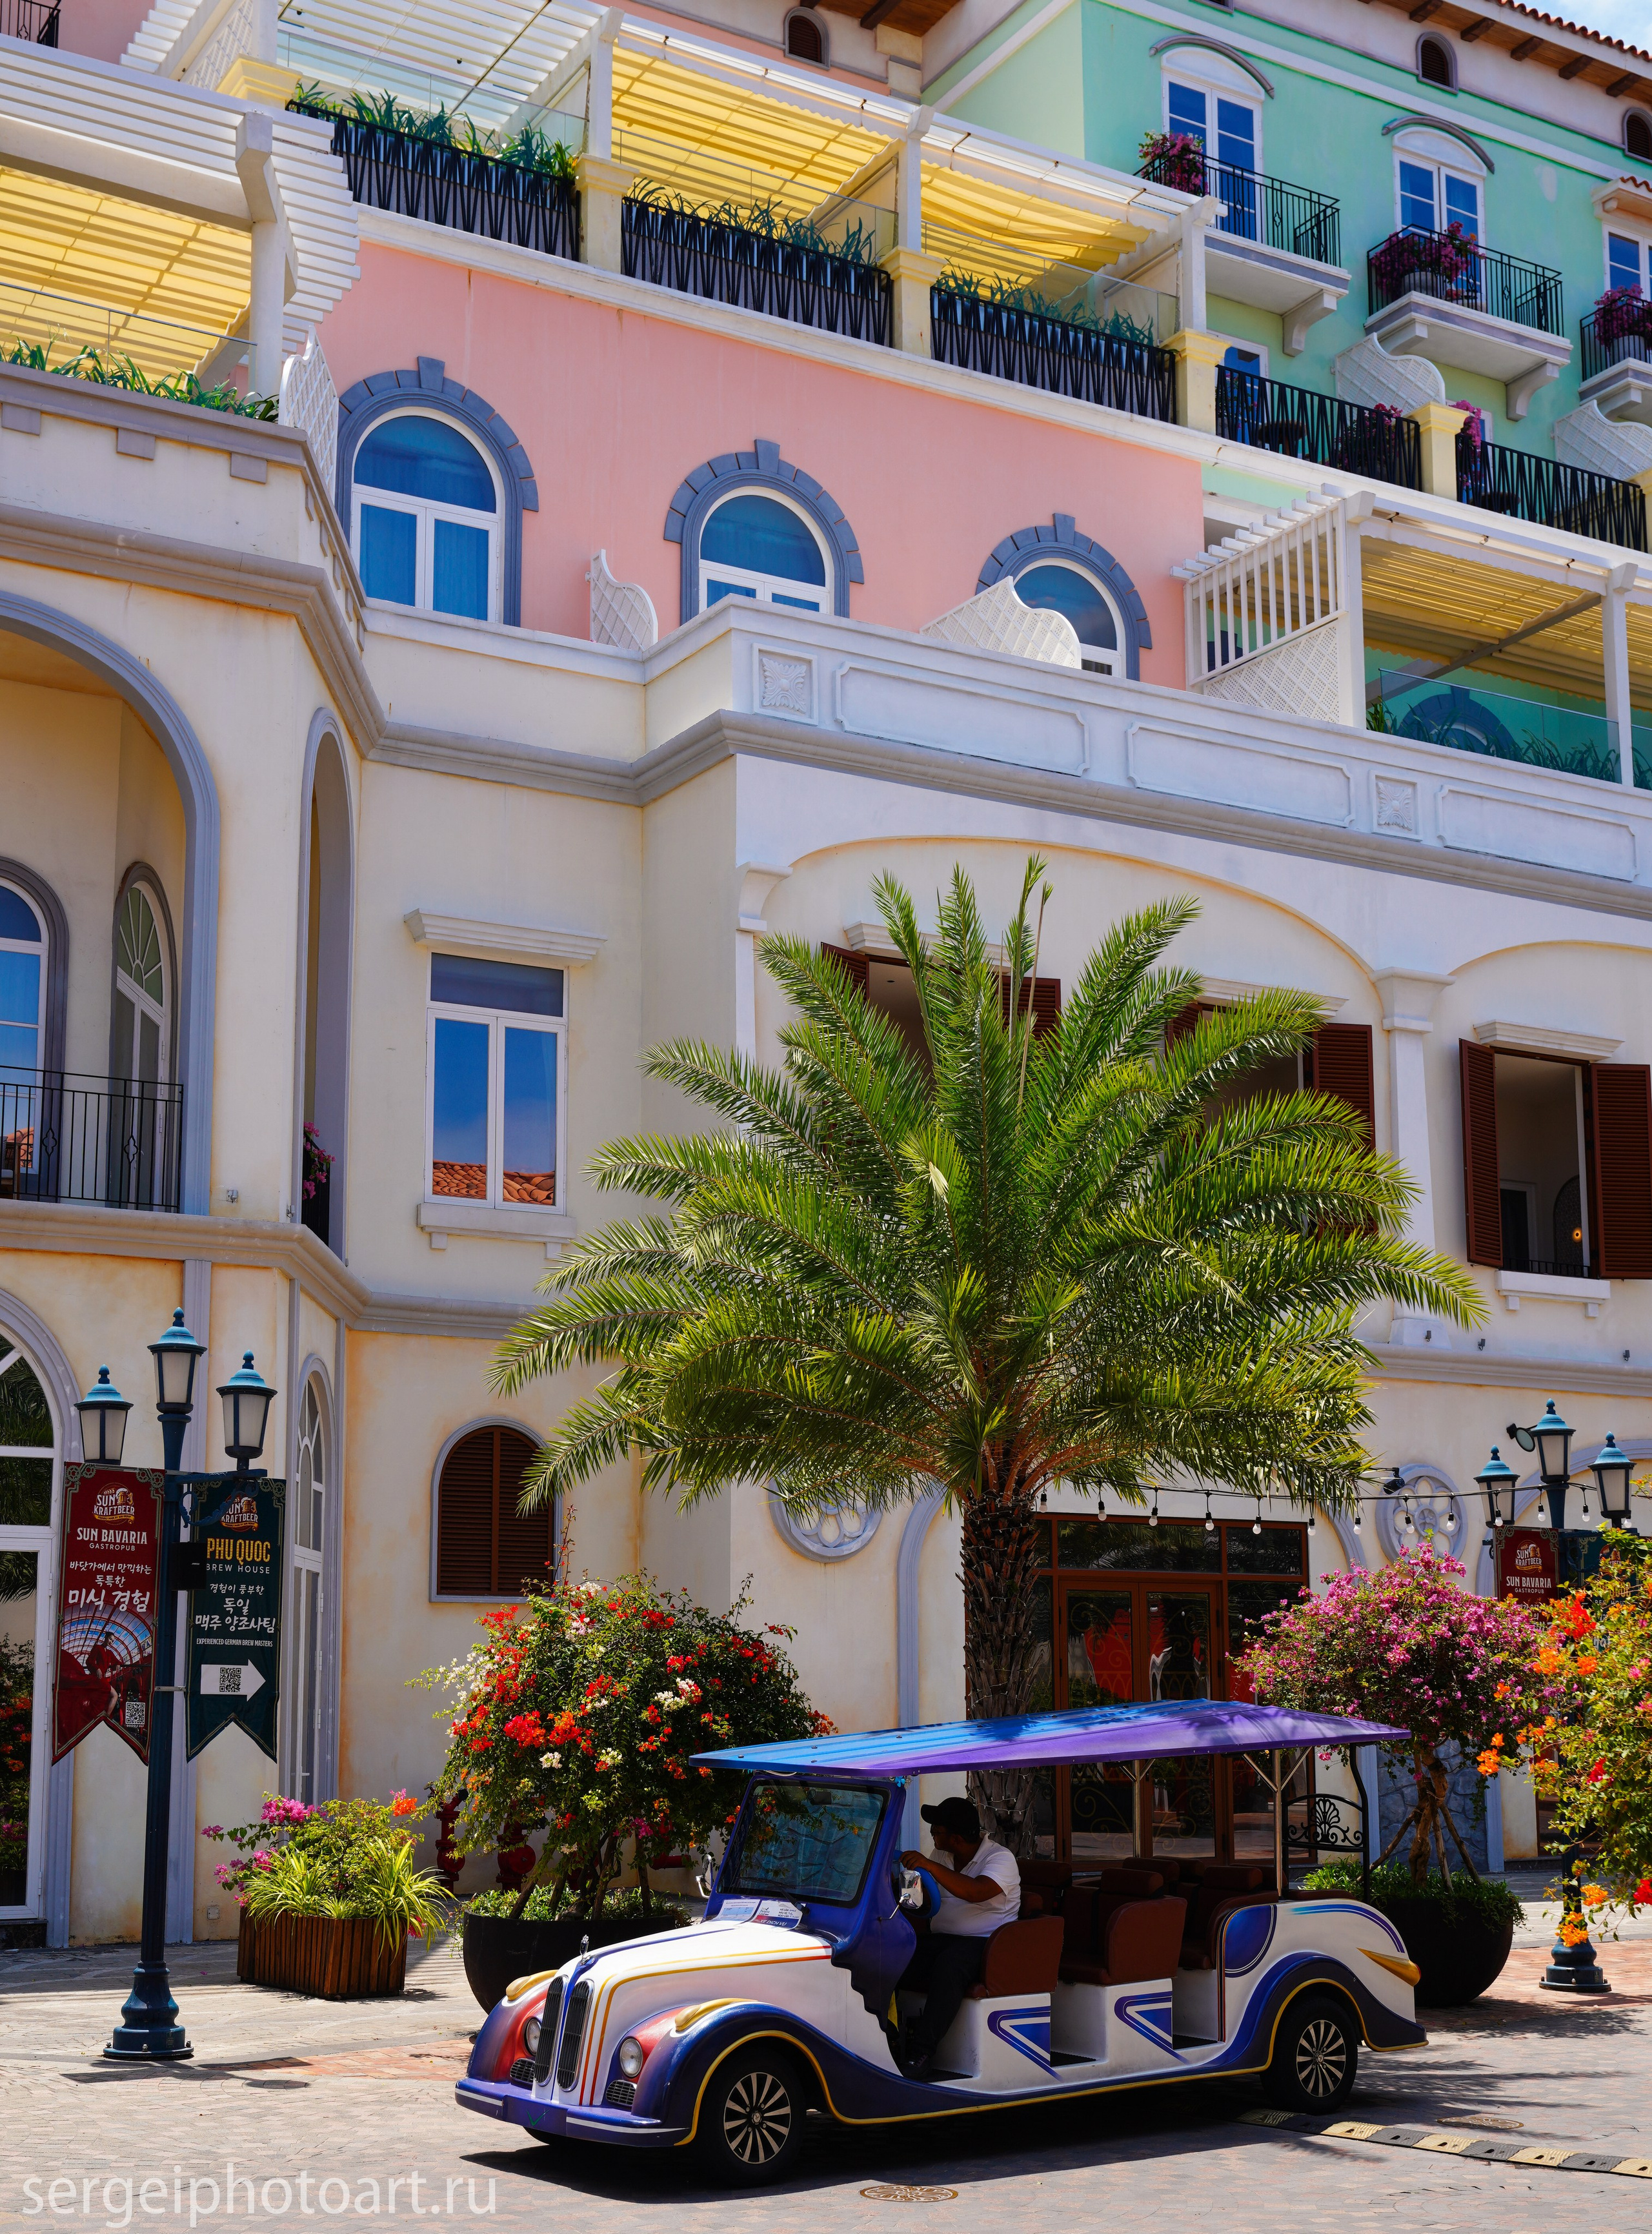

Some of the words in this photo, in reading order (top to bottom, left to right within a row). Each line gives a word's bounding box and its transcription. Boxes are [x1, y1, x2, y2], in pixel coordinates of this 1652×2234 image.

[97, 1494, 116, 1506] SUN
[94, 1505, 135, 1516] KRAFTBEER
[226, 1503, 241, 1514] UN
[221, 1513, 258, 1523] KRAFTBEER
[77, 1527, 98, 1541] SUN
[101, 1529, 148, 1545] BAVARIA
[89, 1543, 136, 1551] GASTROPUB
[206, 1538, 234, 1560] PHU
[236, 1539, 271, 1565] QUOC
[1516, 1549, 1529, 1559] SUN
[70, 1561, 116, 1572] 바닷가에서
[117, 1563, 152, 1574] 만끽하는
[1515, 1557, 1542, 1566] KRAFTBEER
[206, 1563, 232, 1572] BREW
[237, 1565, 270, 1574] HOUSE
[95, 1575, 126, 1588] 독특한
[1506, 1576, 1520, 1587] SUN
[1522, 1577, 1552, 1588] BAVARIA
[210, 1583, 236, 1594] 경험이
[239, 1585, 265, 1595] 풍부한
[68, 1588, 106, 1610] 미식
[112, 1589, 150, 1612] 경험
[223, 1598, 250, 1615] 독일
[195, 1614, 222, 1630] 맥주
[225, 1616, 276, 1633] 양조사팀
